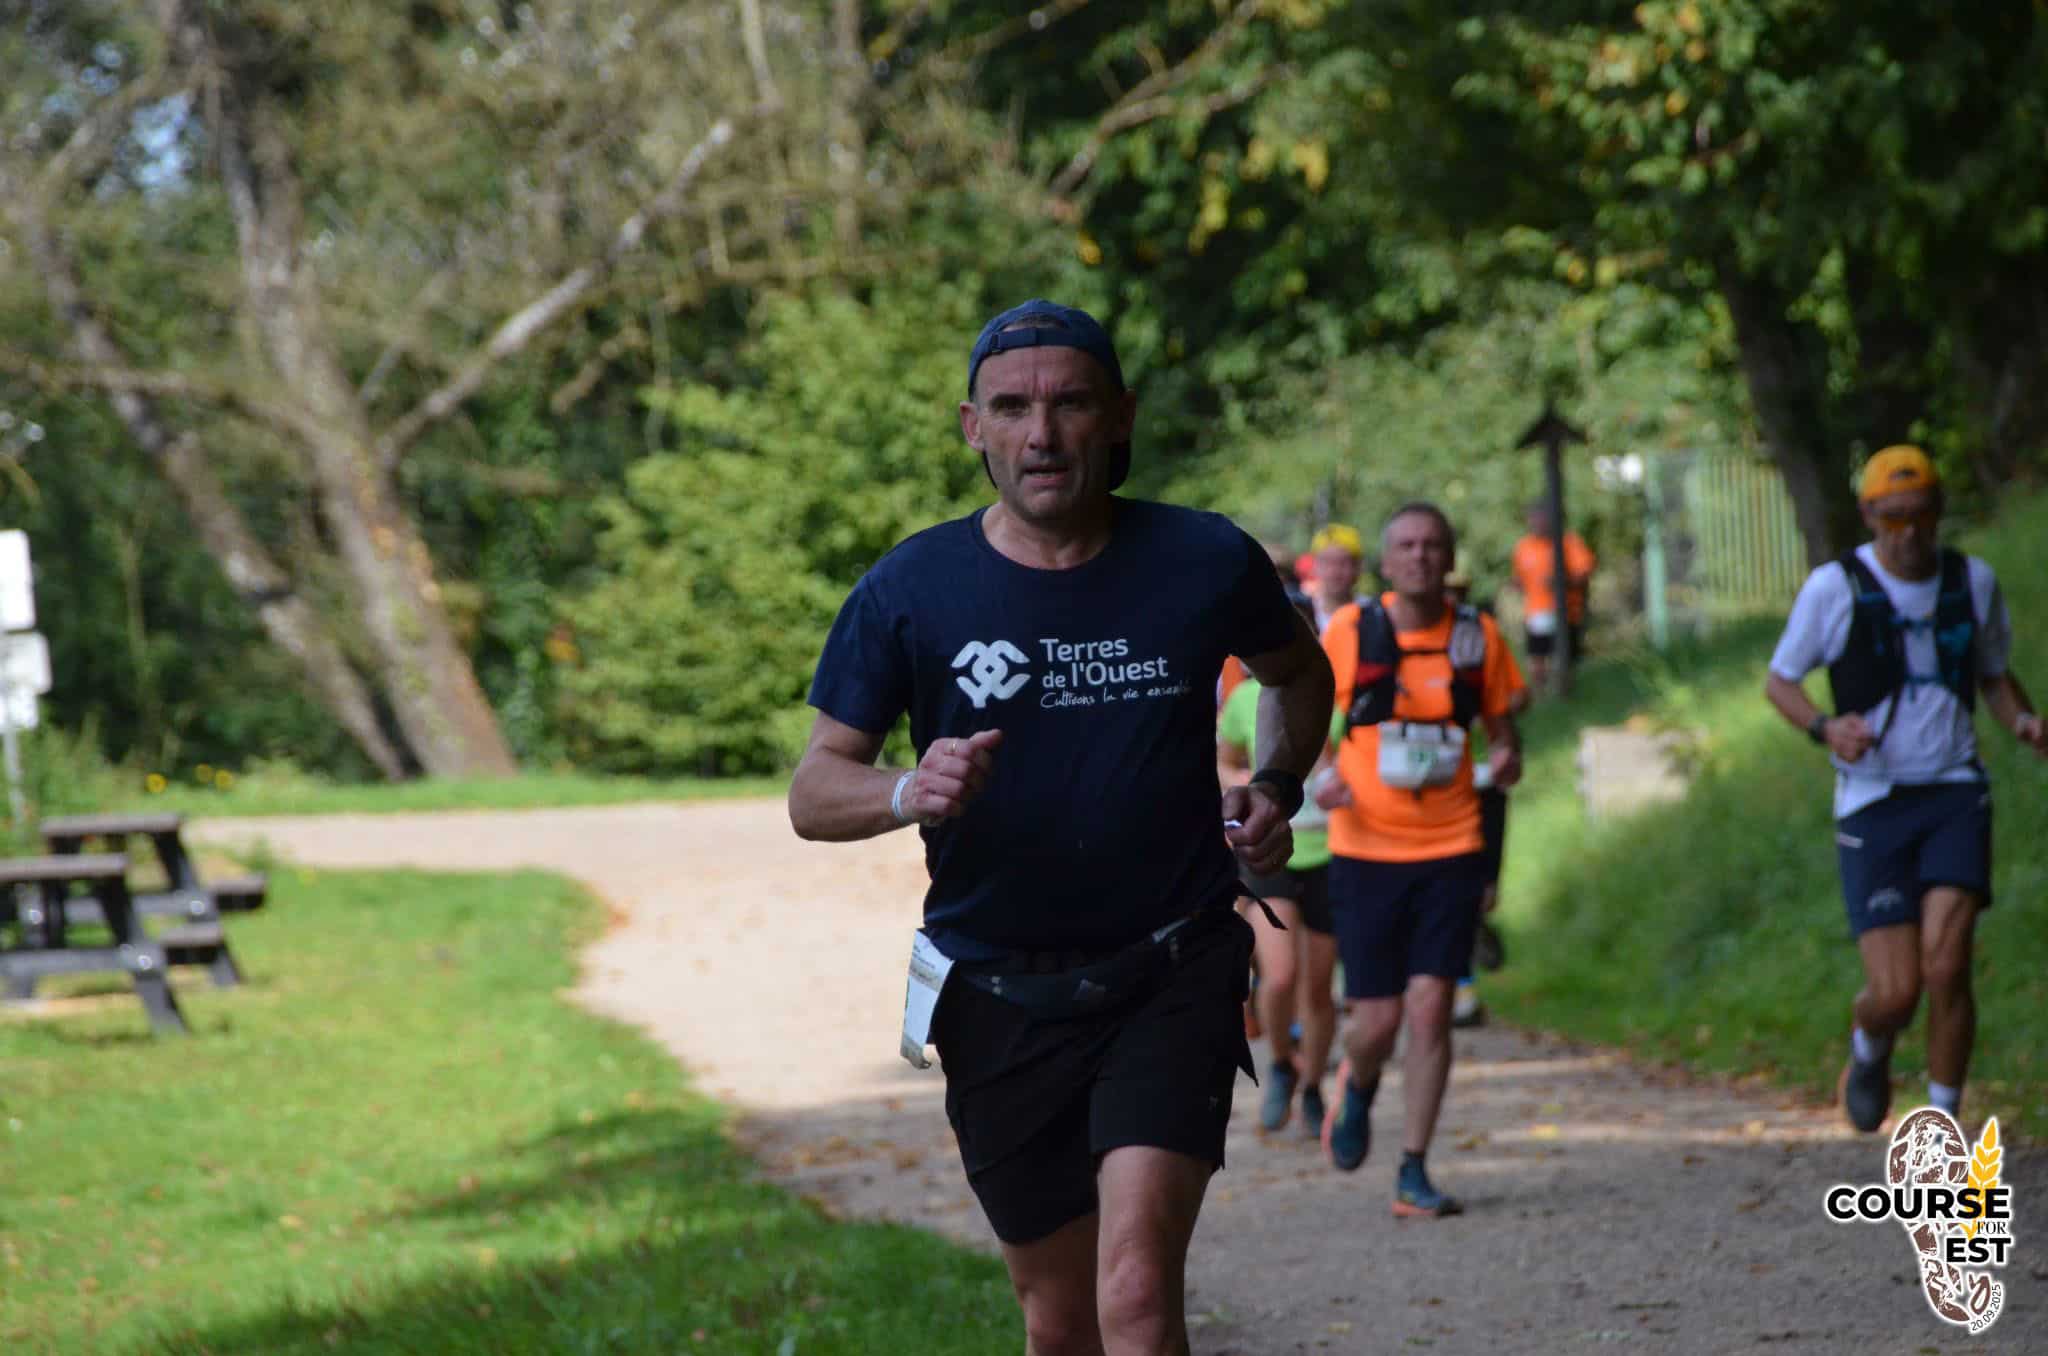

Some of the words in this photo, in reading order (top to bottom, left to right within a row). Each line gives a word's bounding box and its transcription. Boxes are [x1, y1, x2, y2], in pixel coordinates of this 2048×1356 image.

[1040, 638, 1128, 662] Terres
[1042, 671, 1066, 688] de
[1072, 657, 1168, 687] l'Ouest
[1122, 688, 1139, 700] vie
